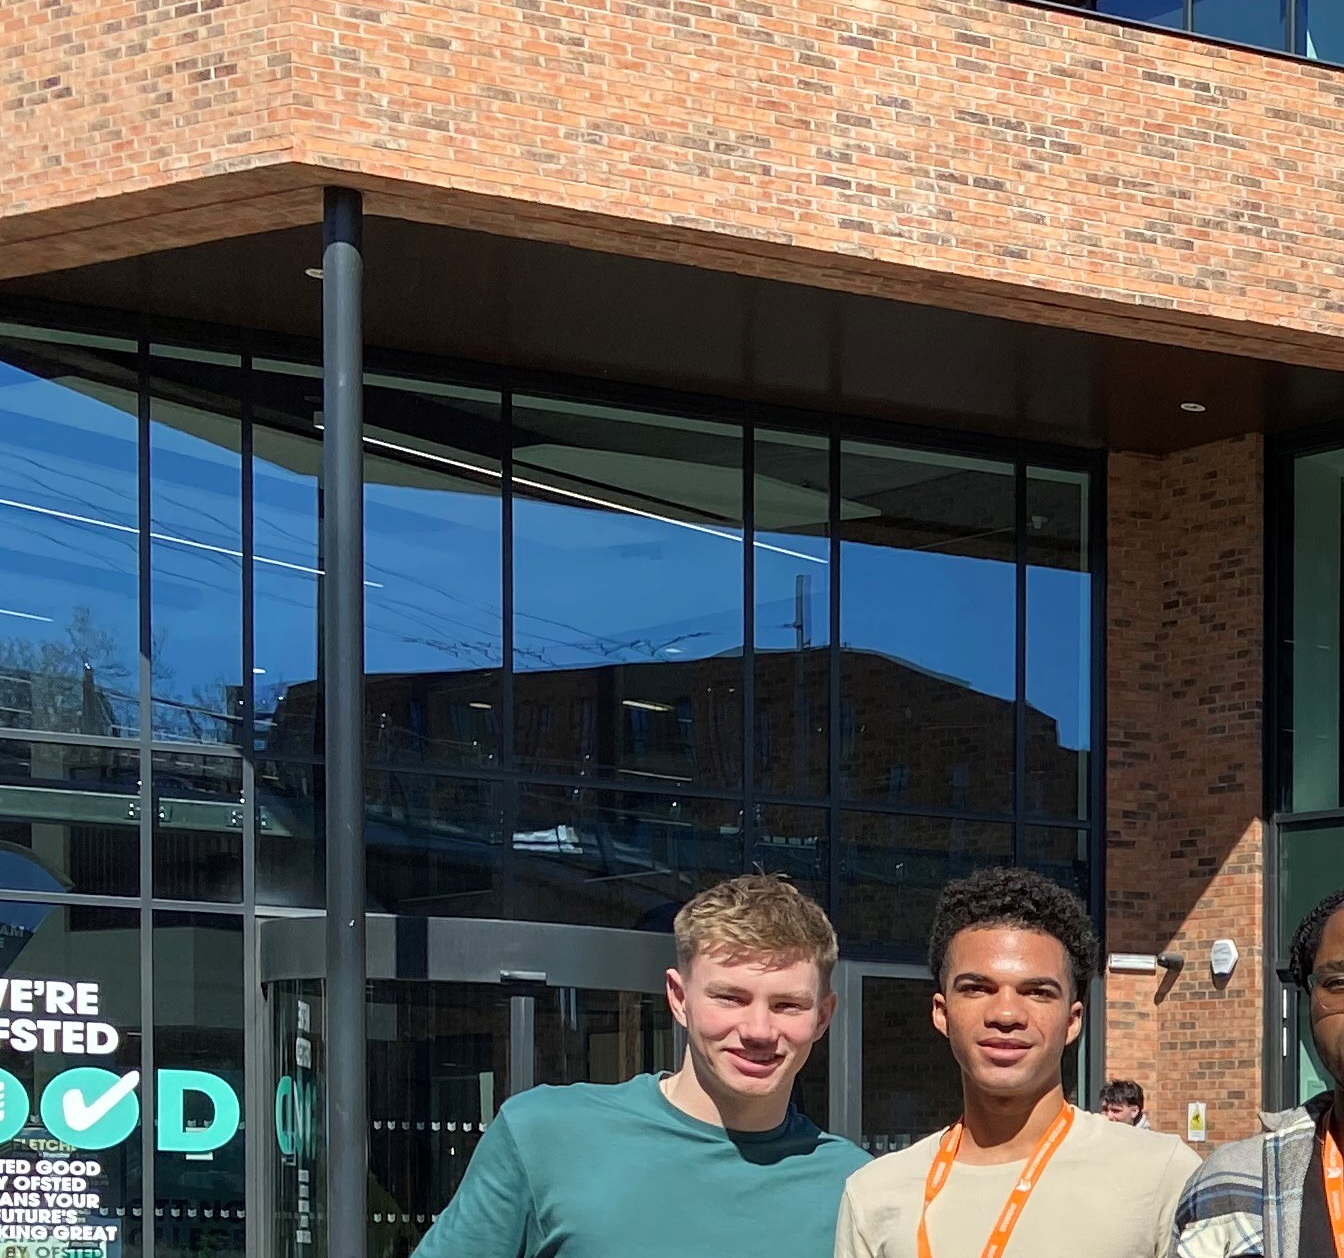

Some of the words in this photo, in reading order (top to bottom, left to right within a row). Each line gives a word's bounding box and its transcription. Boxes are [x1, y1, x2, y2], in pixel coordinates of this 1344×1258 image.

[0, 978, 99, 1015] E'RE
[36, 1160, 101, 1176] GOOD
[13, 1176, 87, 1192] OFSTED
[43, 1193, 100, 1209] YOUR
[53, 1225, 118, 1242] GREAT
